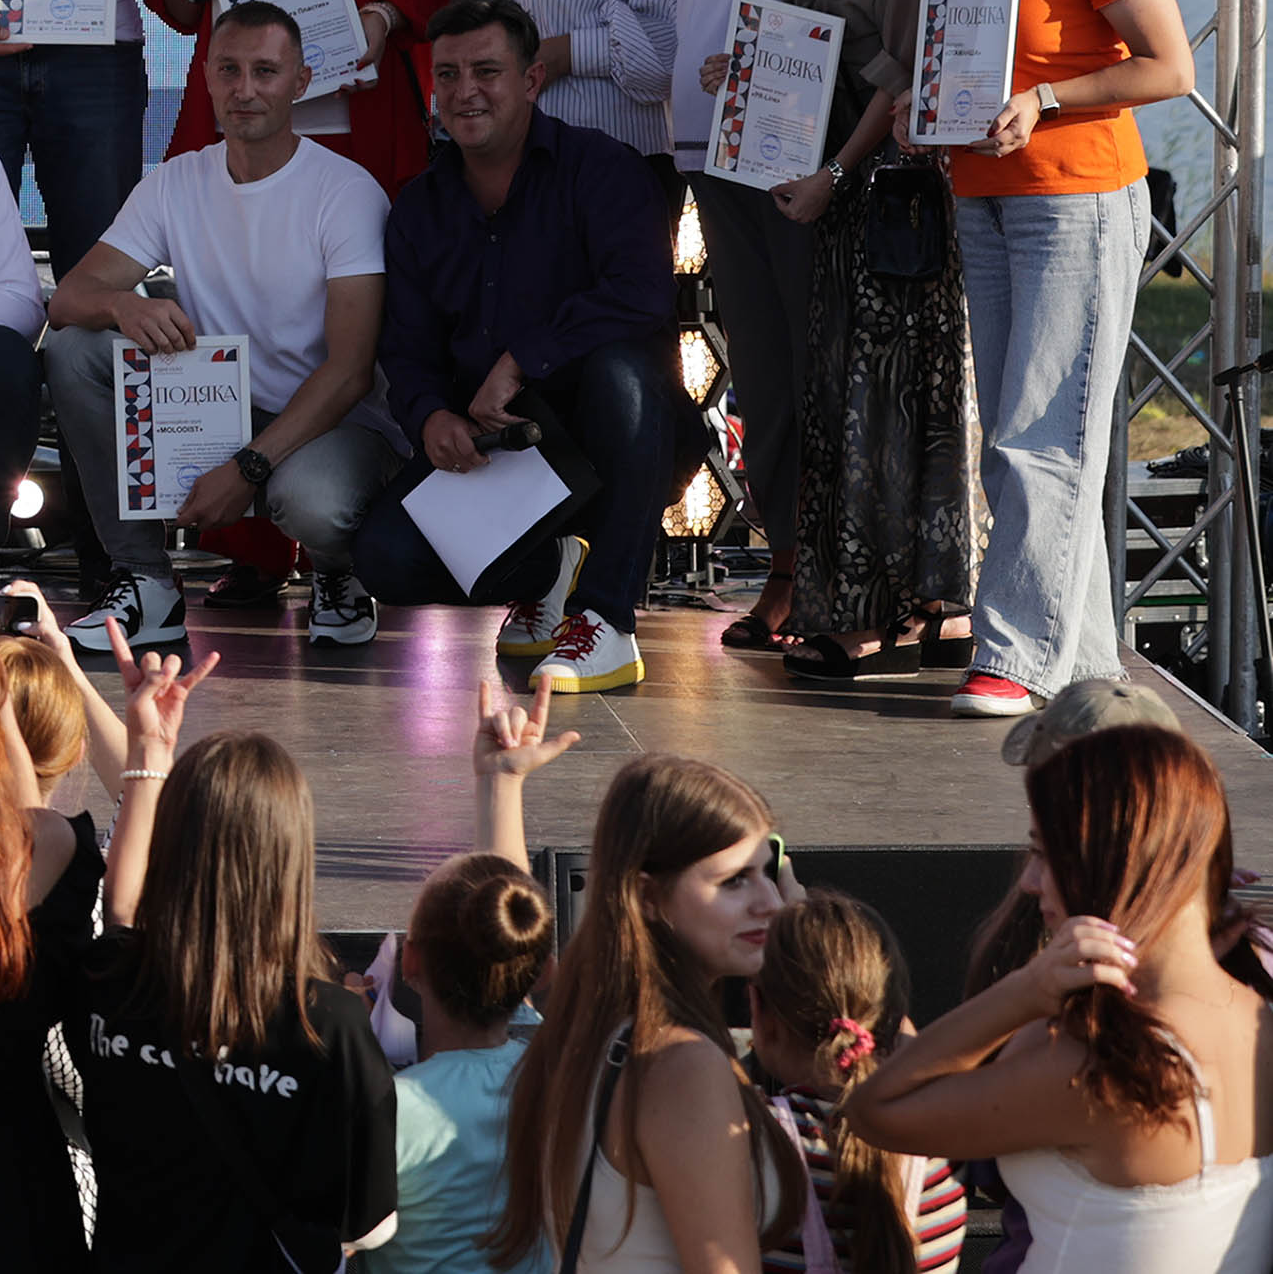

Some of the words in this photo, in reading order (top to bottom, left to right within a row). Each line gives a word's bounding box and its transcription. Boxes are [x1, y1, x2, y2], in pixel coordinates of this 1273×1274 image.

[948, 5, 1006, 27] ПОДЯКА
[756, 49, 823, 84] ПОДЯКА
[155, 385, 238, 406] ПОДЯКА
